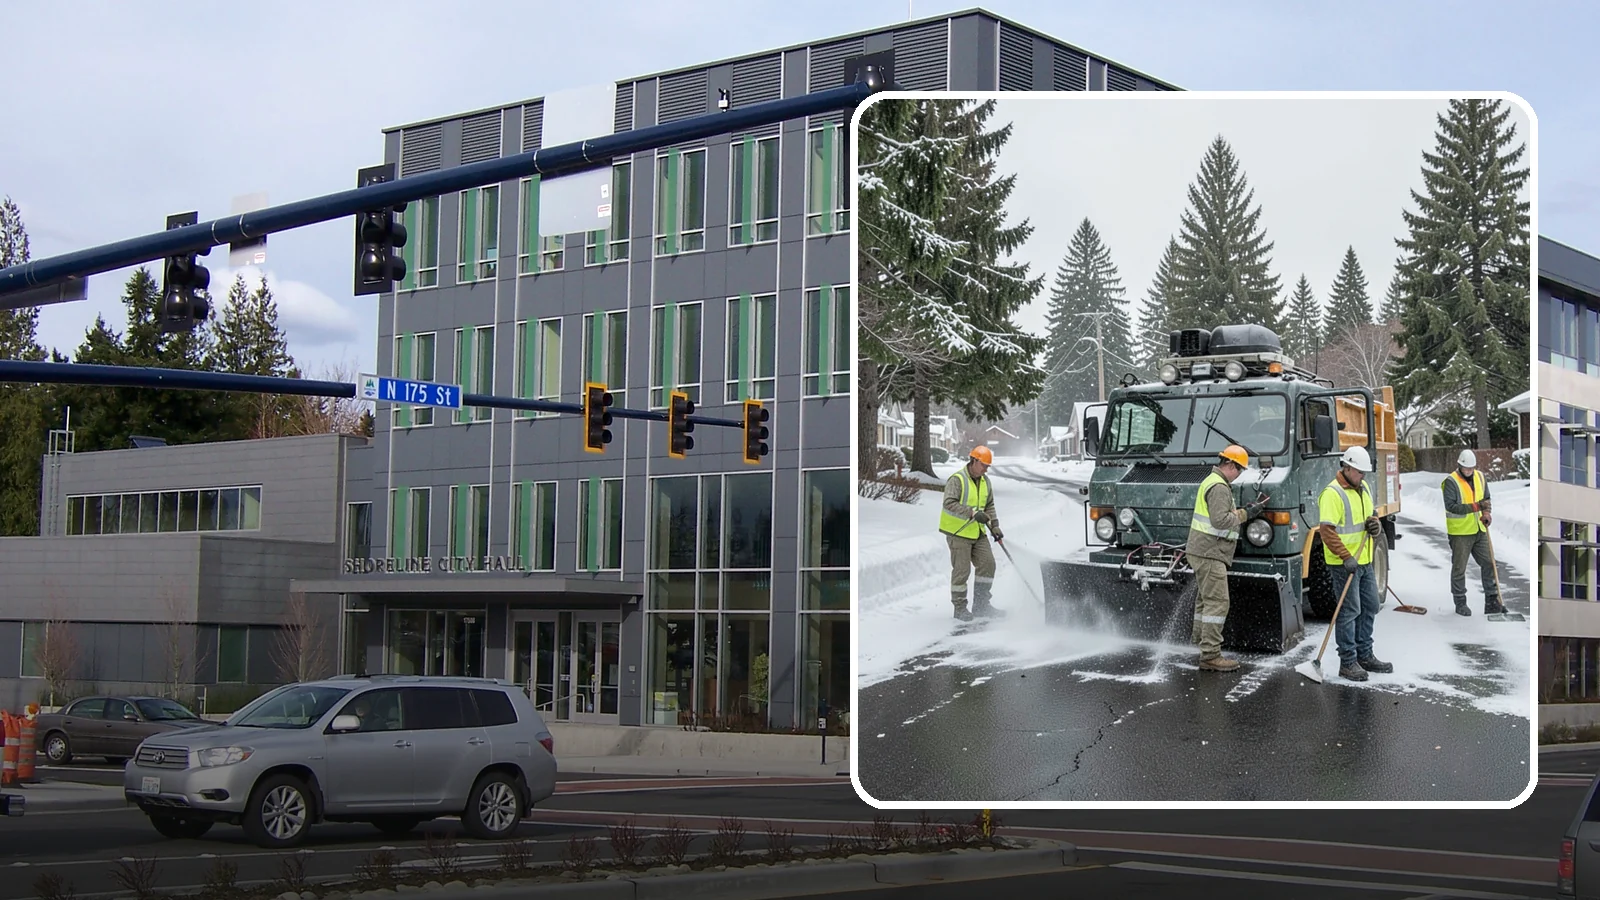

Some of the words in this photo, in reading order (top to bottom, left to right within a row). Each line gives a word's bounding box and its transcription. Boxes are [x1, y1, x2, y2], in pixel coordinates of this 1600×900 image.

[387, 380, 396, 399] N
[405, 383, 428, 403] 175
[436, 387, 451, 405] St
[344, 557, 432, 574] SHORELINE
[438, 557, 476, 572] CITY
[484, 556, 526, 571] HALL
